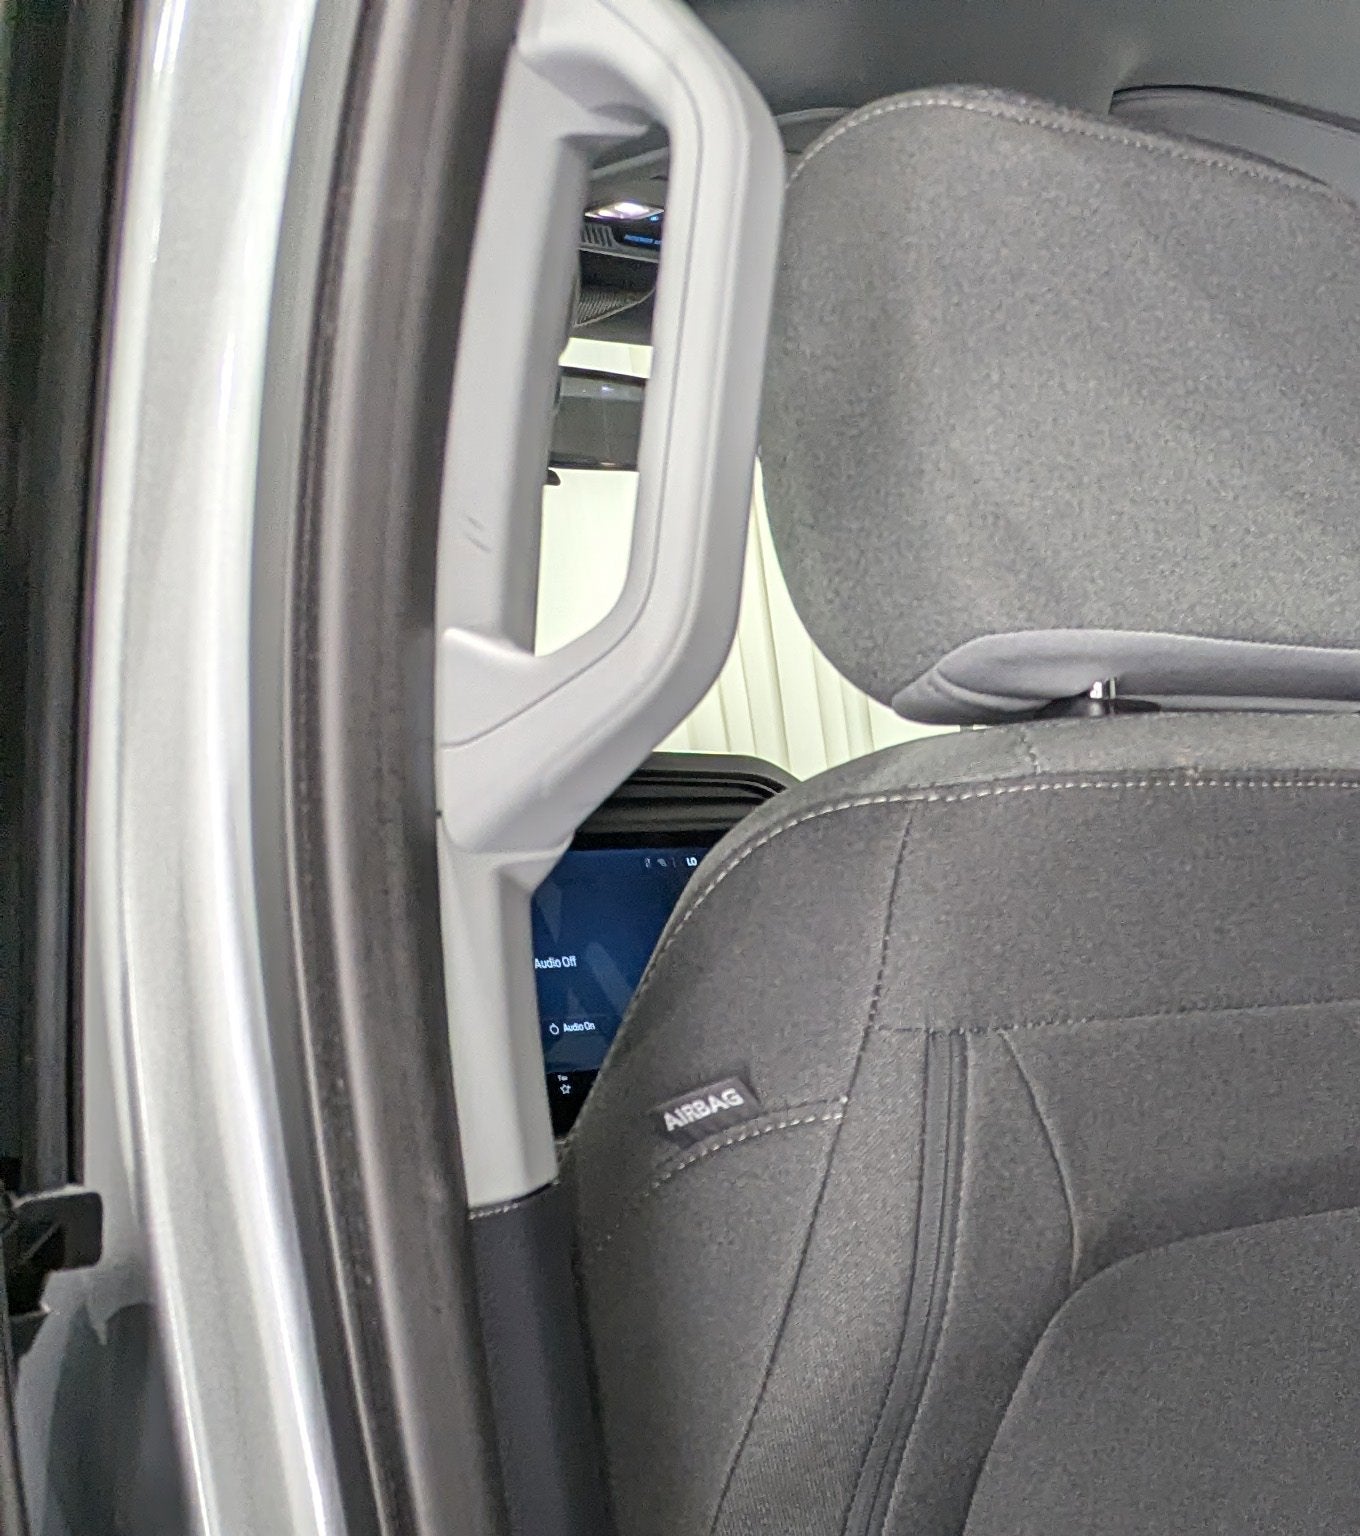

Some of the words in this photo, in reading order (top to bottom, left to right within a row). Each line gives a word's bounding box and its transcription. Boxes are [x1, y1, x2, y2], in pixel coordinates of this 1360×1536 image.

[534, 956, 562, 969] Audio
[562, 955, 577, 967] Off
[563, 1022, 584, 1033] Audio
[584, 1021, 596, 1031] On
[663, 1087, 745, 1131] AIRBAG
